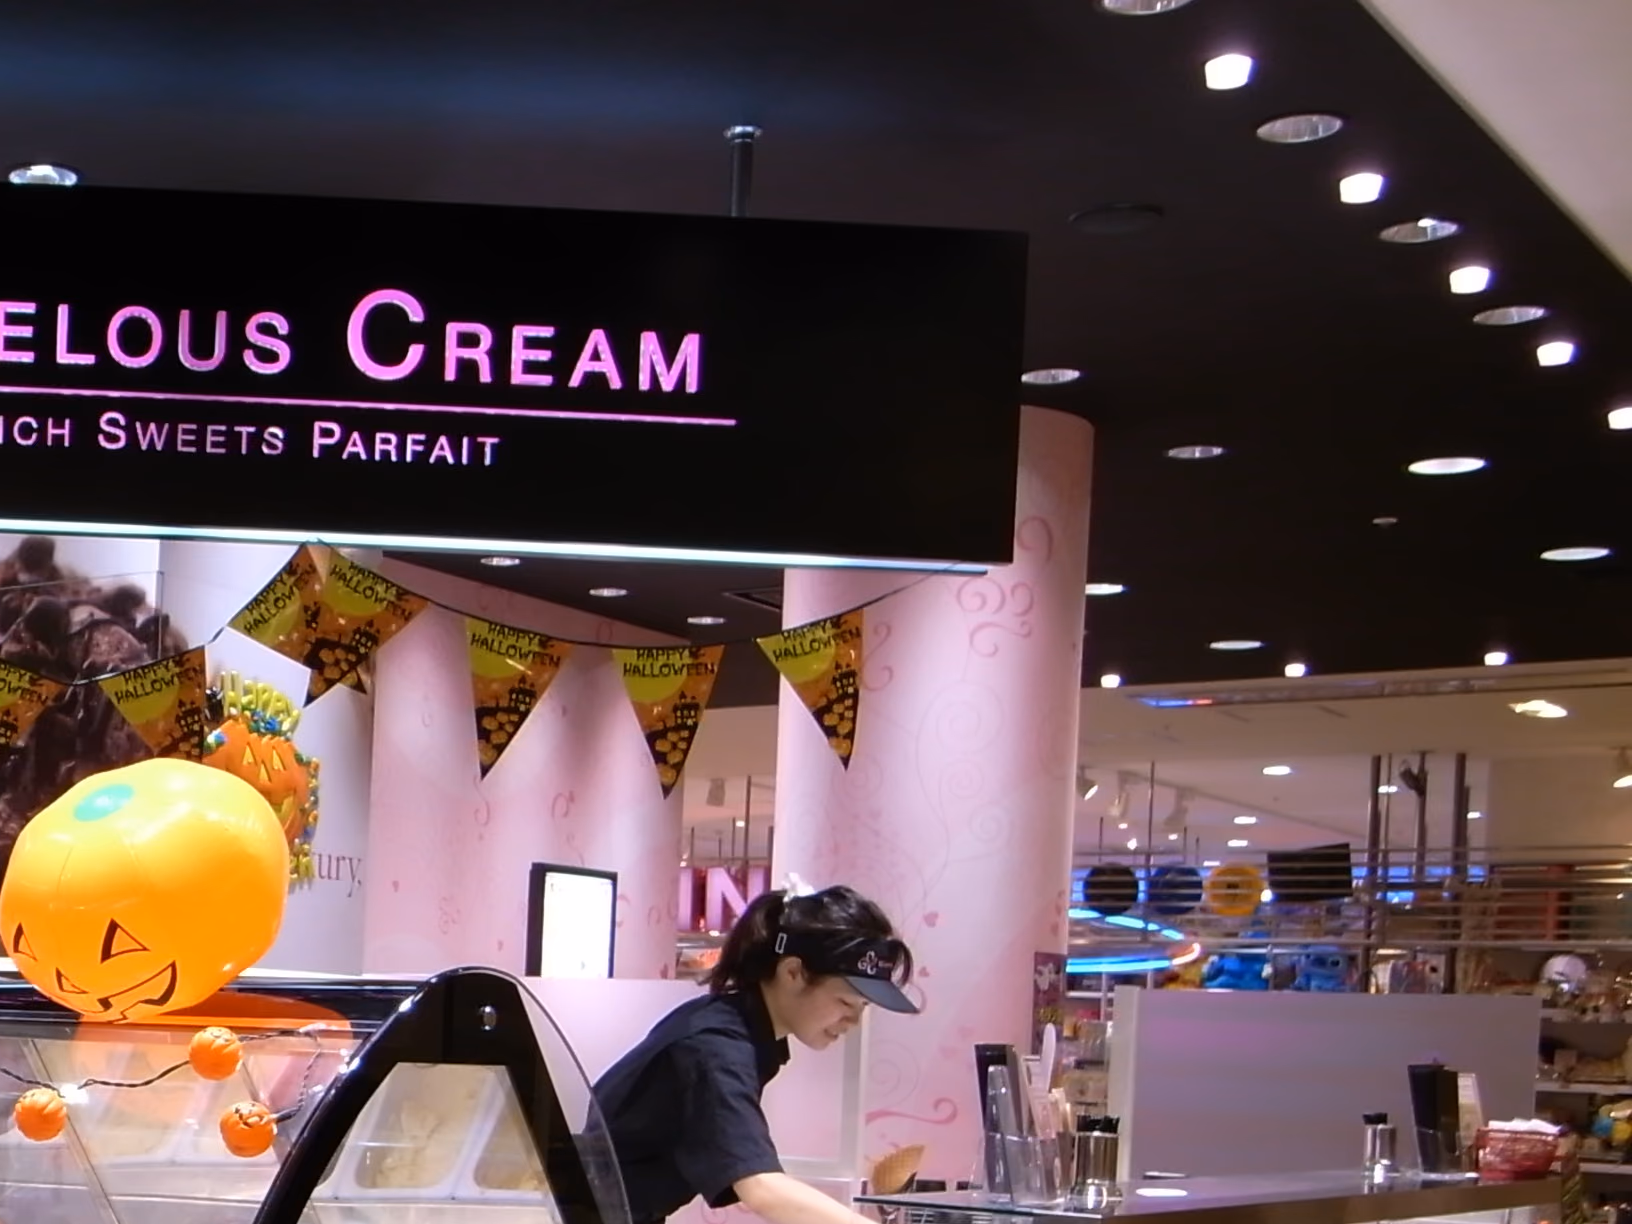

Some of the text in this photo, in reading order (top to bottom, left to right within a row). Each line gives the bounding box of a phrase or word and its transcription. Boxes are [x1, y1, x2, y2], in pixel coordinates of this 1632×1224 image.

[345, 287, 702, 395] CREAM
[96, 410, 285, 455] SWEETS
[311, 420, 500, 466] PARFAIT
[329, 564, 413, 622] HALLOWEEN
[347, 561, 395, 593] HAPPY
[487, 622, 538, 647] HAPPY
[772, 627, 862, 662] HALLOWEEN
[781, 619, 831, 643] HAPPY
[470, 633, 561, 668] HALLOWEEN
[635, 647, 688, 661] HAPPY
[114, 666, 204, 705] HALLOWEEN
[122, 658, 176, 684] HAPPY
[622, 661, 715, 679] HALLOWEEN
[311, 852, 363, 898] ury,
